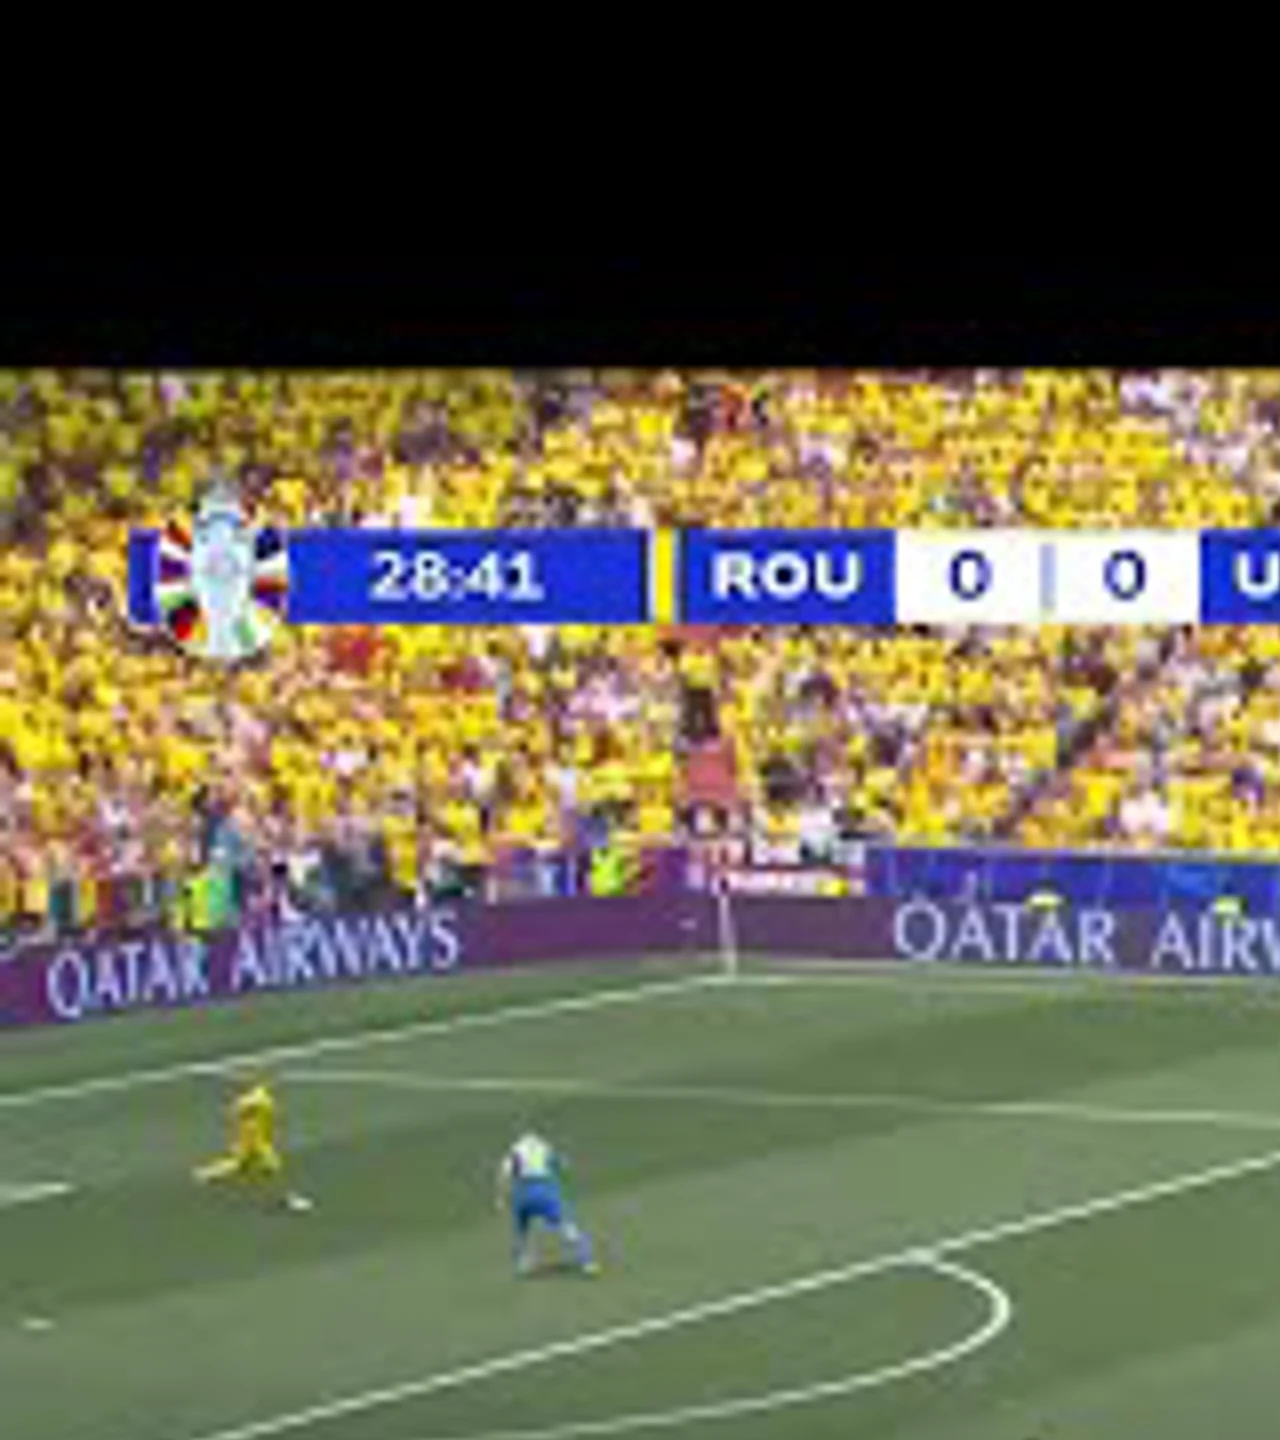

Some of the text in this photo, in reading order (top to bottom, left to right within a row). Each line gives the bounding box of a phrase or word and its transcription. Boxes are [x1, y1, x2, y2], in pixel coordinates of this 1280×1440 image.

[46, 912, 460, 1018] QATAR AIRWAYS
[893, 899, 1115, 964] QATAR
